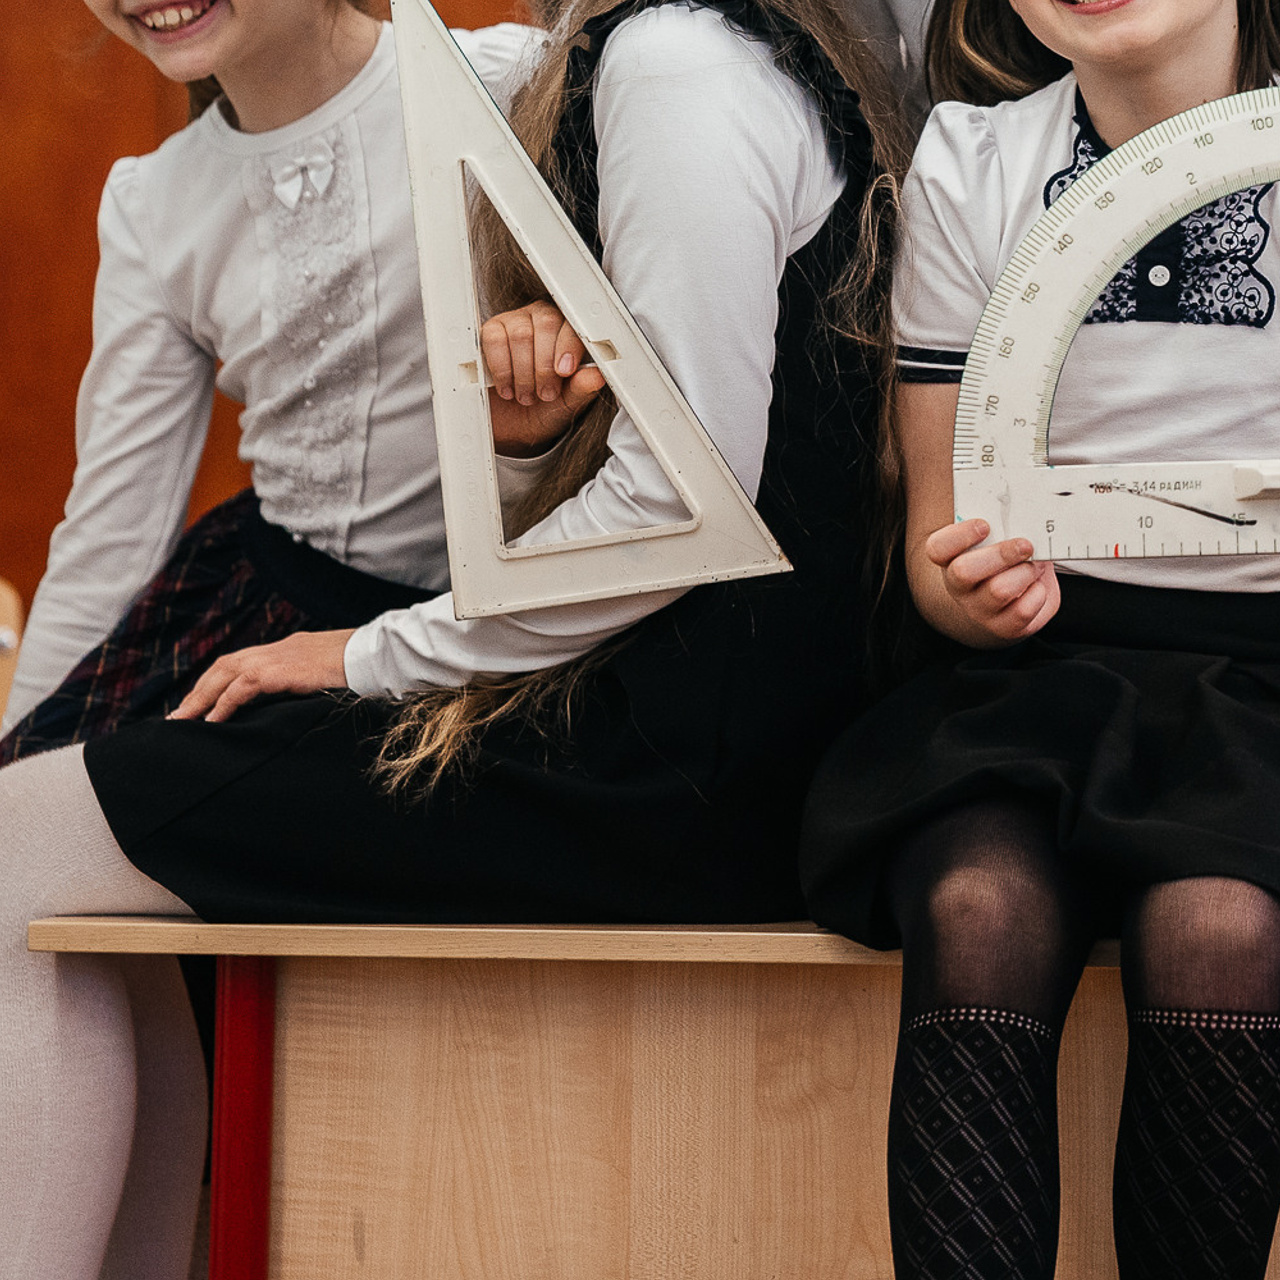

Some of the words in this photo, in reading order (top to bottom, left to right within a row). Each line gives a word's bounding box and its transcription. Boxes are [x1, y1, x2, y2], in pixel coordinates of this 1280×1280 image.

[1250, 116, 1274, 132] 100
[1193, 132, 1214, 149] 110
[1140, 157, 1164, 176] 120
[1094, 191, 1115, 211] 130
[1052, 233, 1074, 255] 140
[1013, 418, 1027, 428] 3
[1186, 172, 1197, 186] 2
[1020, 282, 1041, 305] 150
[998, 336, 1015, 359] 160
[984, 395, 1000, 416] 170
[981, 444, 995, 468] 180
[1159, 480, 1202, 492] РАДИАН
[1046, 520, 1055, 533] 5
[1137, 516, 1153, 529] 10
